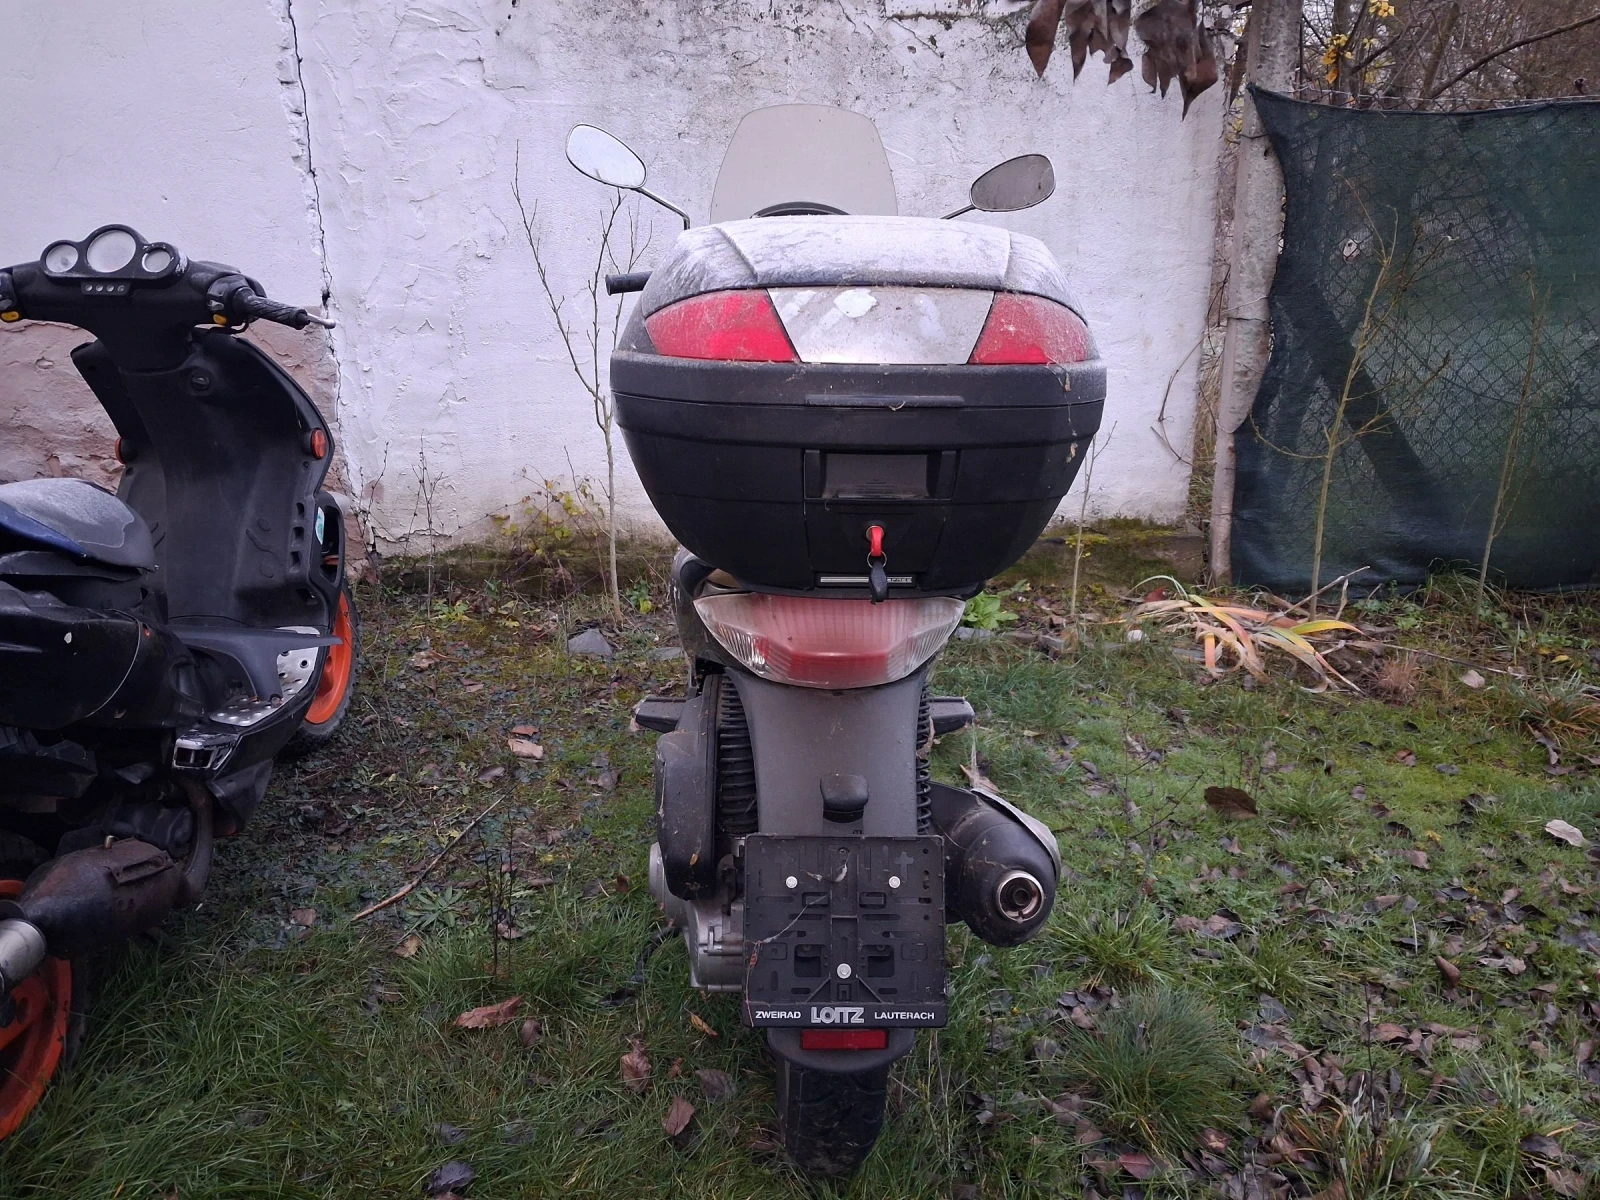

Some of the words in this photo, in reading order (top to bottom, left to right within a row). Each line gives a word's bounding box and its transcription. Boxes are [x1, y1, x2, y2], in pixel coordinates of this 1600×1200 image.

[755, 1010, 801, 1019] ZWEIRAD
[810, 1006, 865, 1024] LOITZ
[874, 1011, 935, 1020] LAUTERACH
